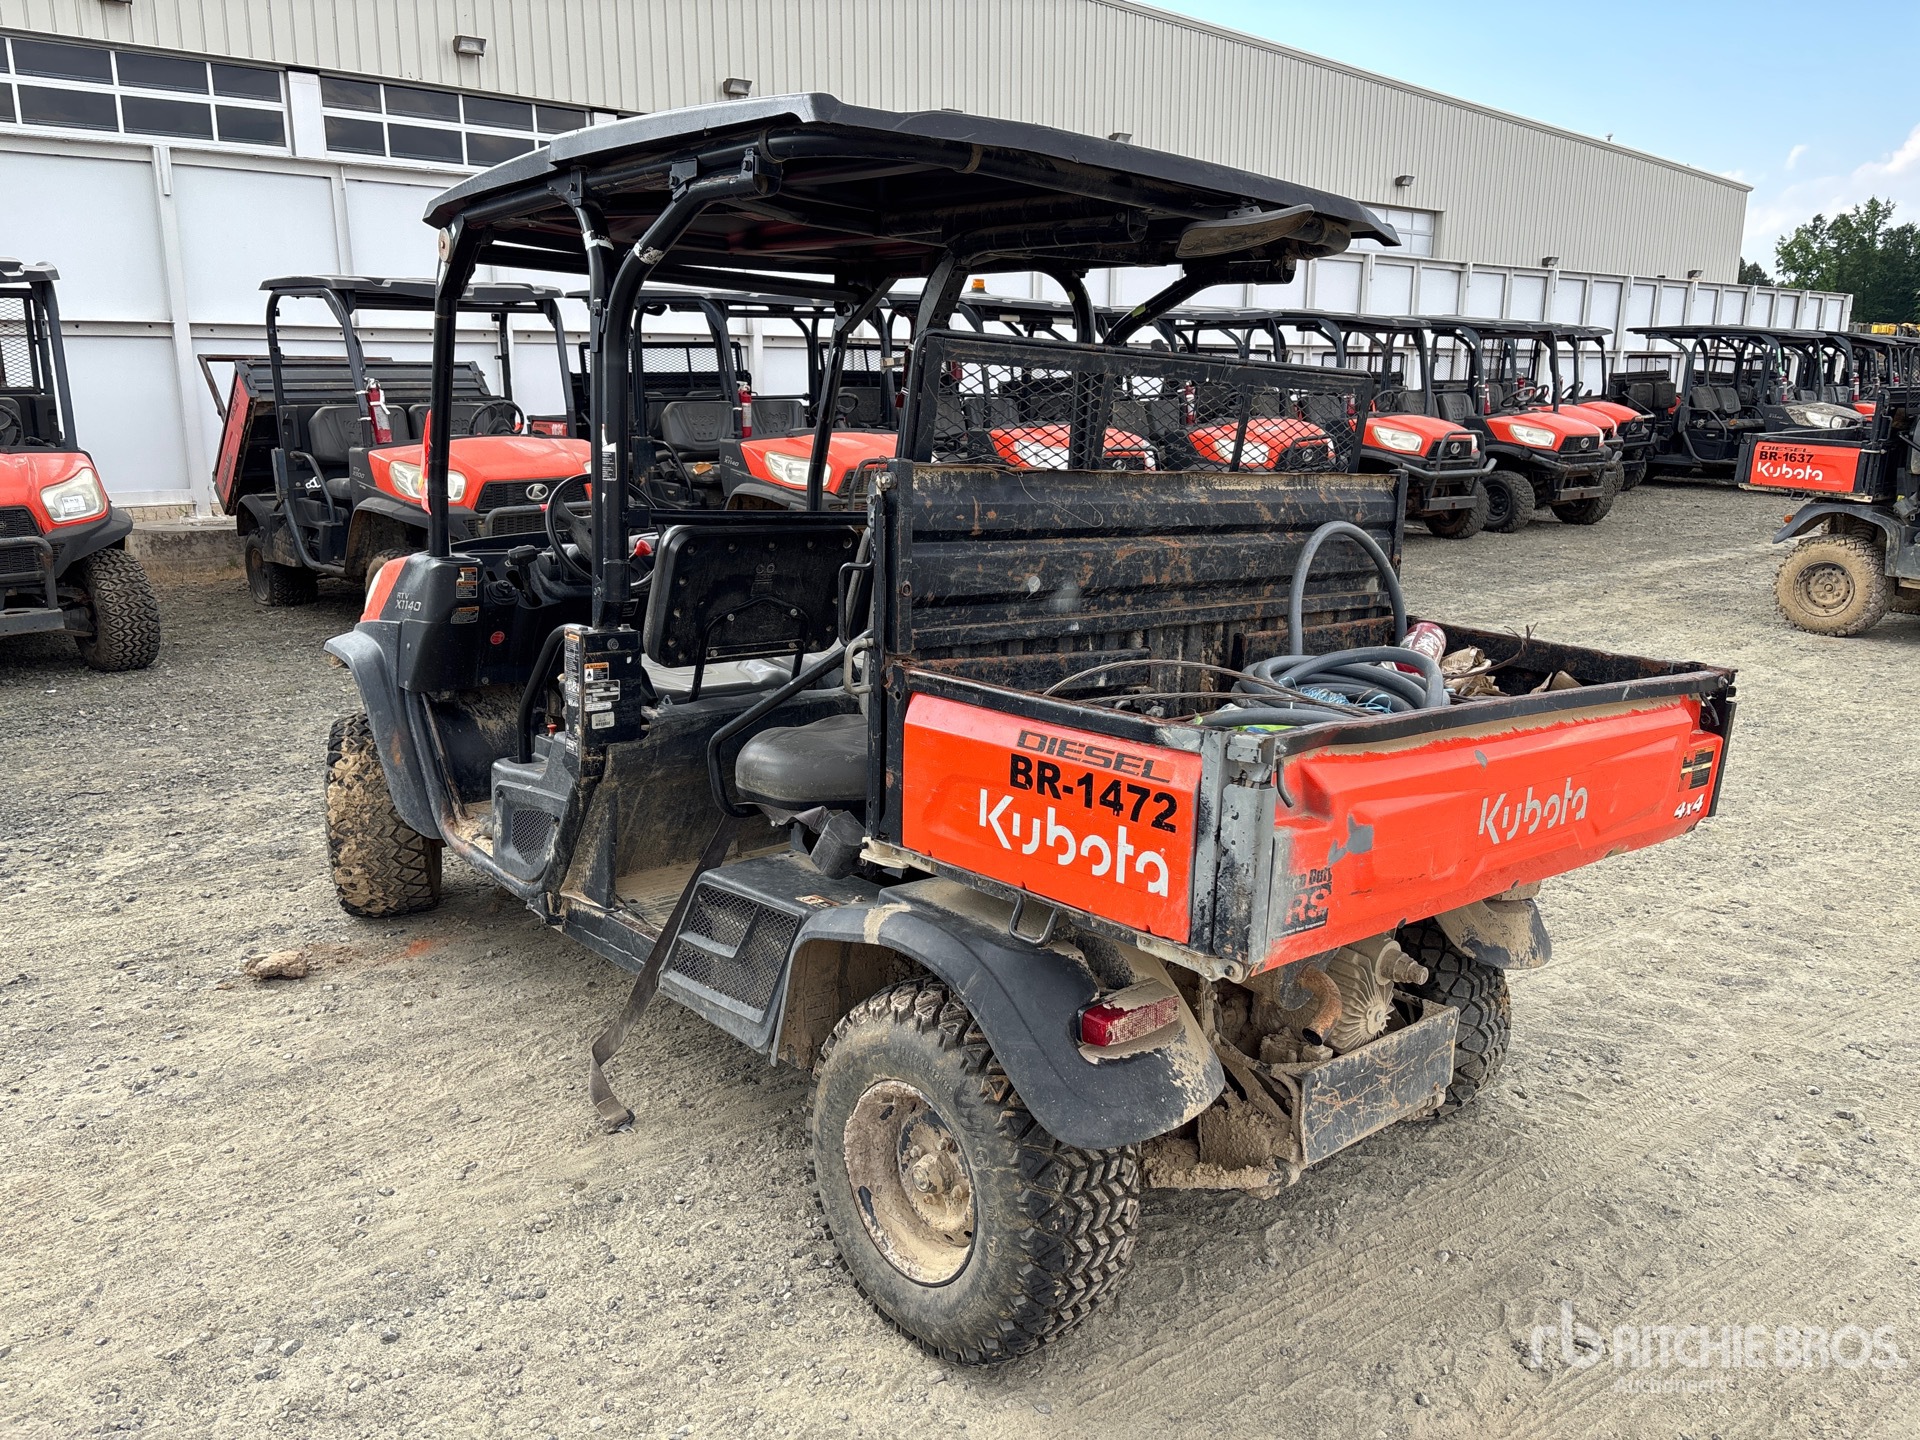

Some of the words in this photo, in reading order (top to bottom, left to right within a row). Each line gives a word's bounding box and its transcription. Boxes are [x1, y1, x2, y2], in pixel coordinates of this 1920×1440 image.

[1759, 452, 1814, 463] BR-1637
[1761, 445, 1813, 453] DIESEL
[1757, 462, 1823, 481] Kubota
[395, 600, 422, 612] X1140
[1016, 730, 1170, 783] DIESEL
[1010, 753, 1177, 833] BR-1472
[1673, 793, 1705, 820] 4x4
[1477, 777, 1589, 845] Kubota
[979, 788, 1169, 897] Kubota
